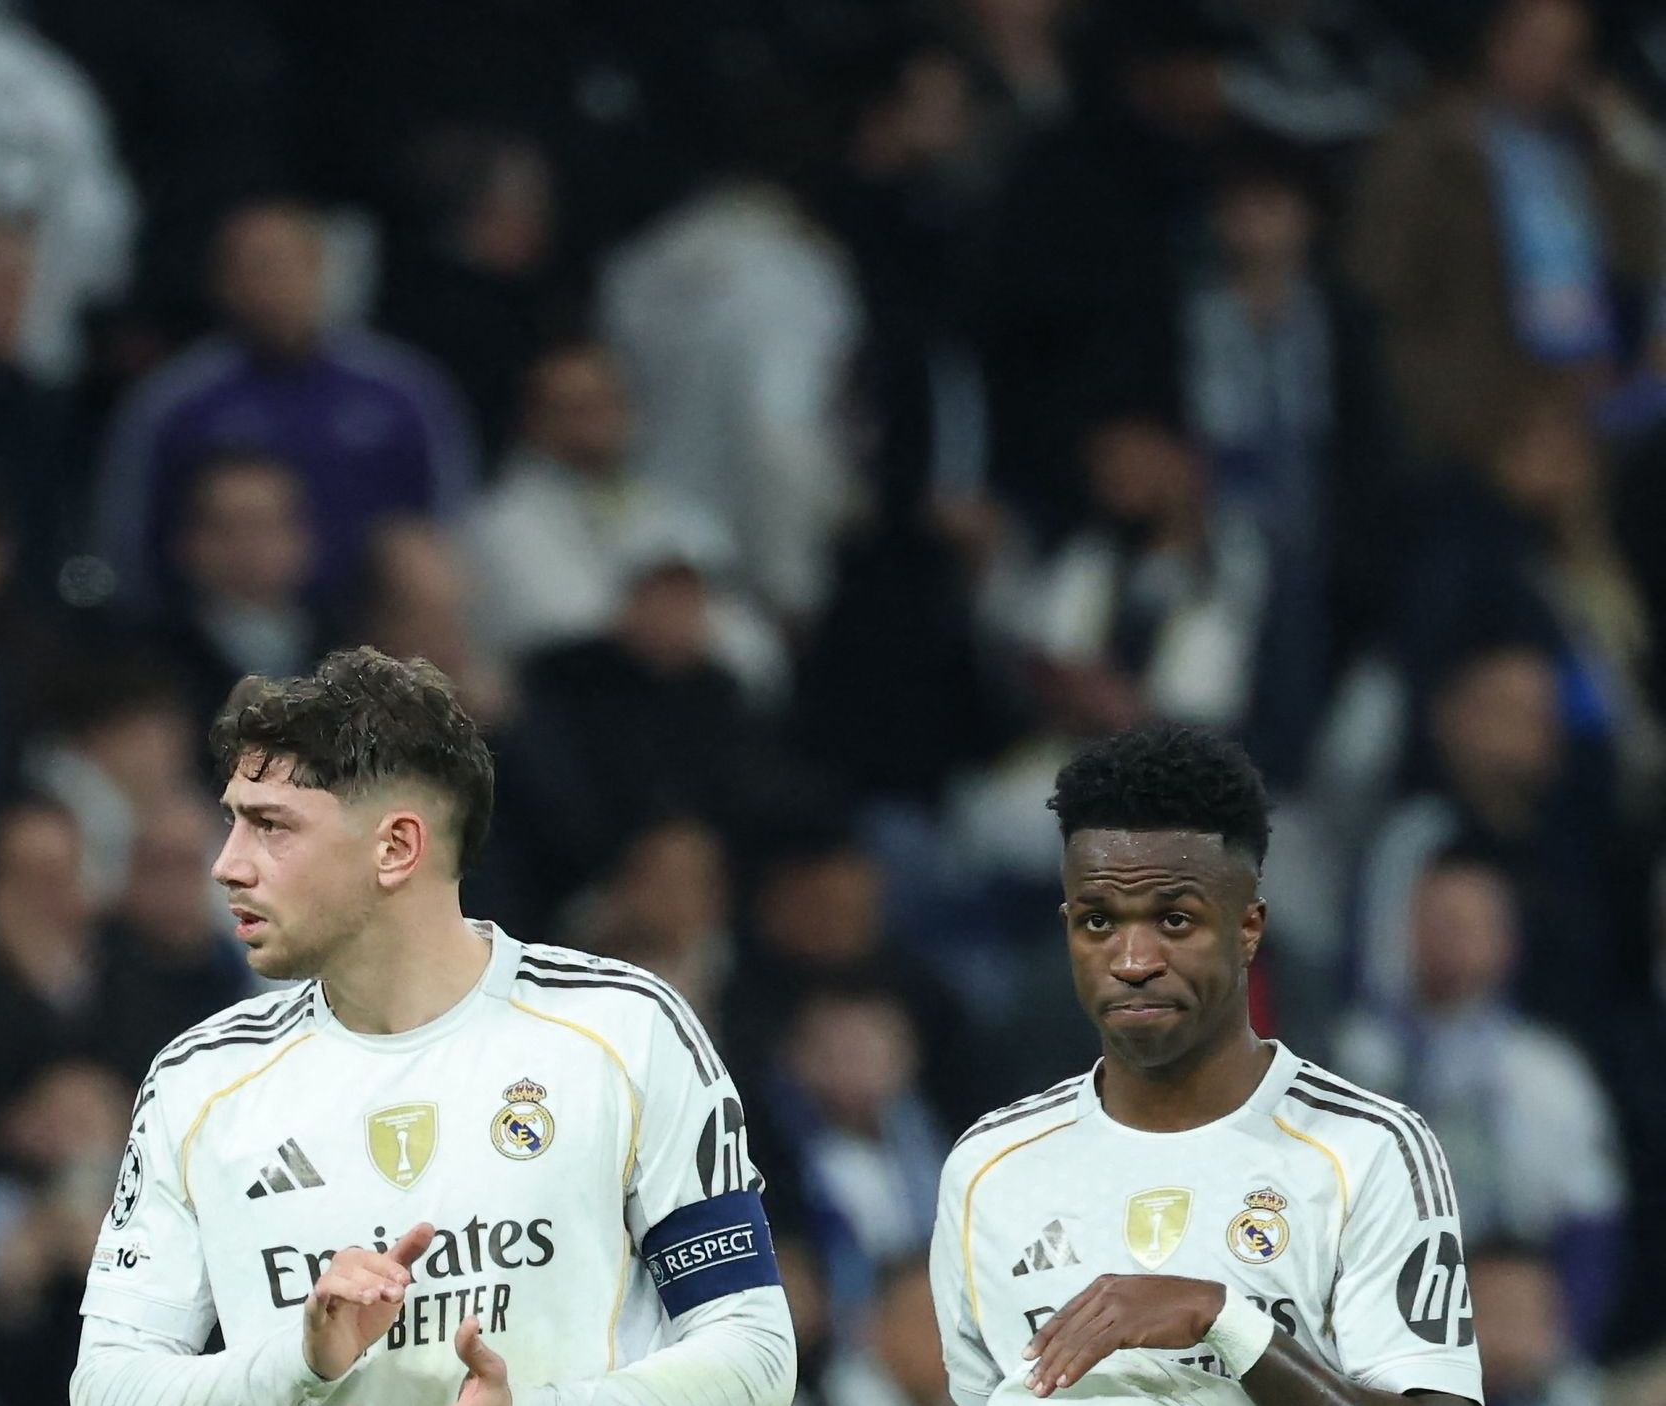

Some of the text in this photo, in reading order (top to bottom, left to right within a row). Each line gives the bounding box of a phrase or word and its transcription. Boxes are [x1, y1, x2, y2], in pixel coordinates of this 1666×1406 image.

[261, 1214, 555, 1308] Eates
[665, 1230, 754, 1275] RESPECT
[1410, 1231, 1473, 1347] hp
